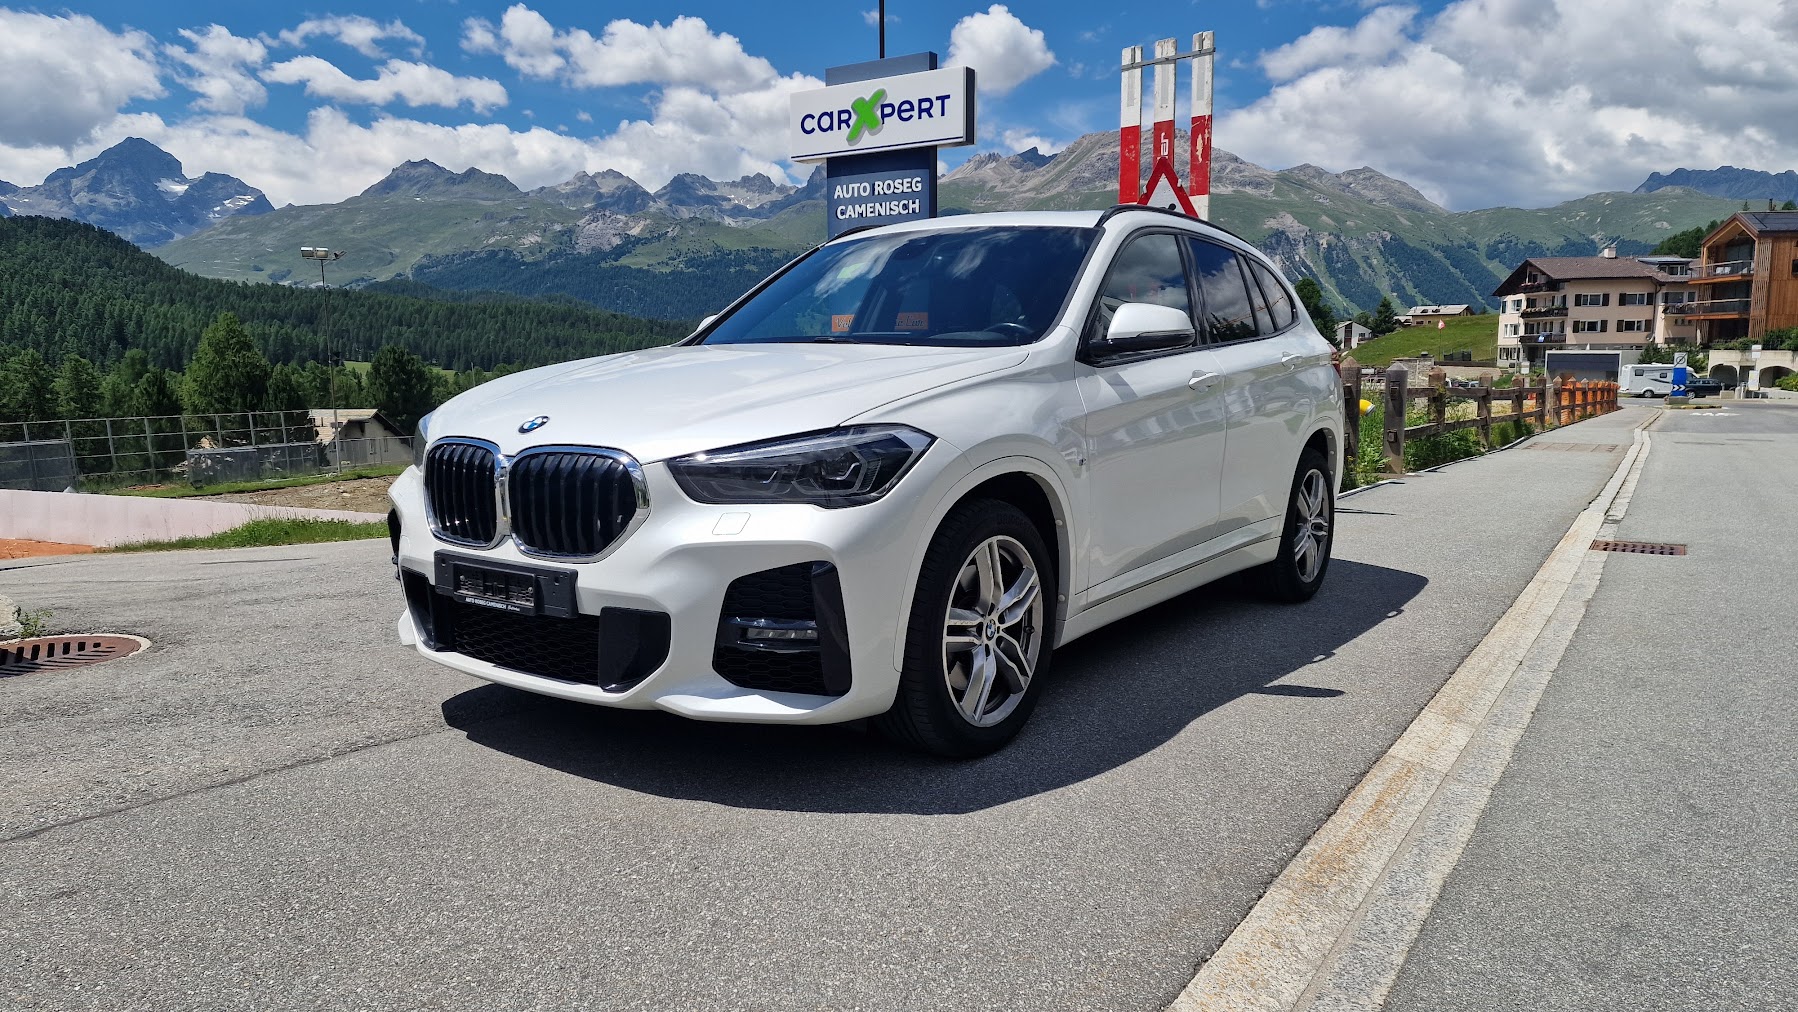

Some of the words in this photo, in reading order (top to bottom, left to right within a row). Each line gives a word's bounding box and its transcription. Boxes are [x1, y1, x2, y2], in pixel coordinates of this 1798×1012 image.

[834, 182, 870, 199] AUTO
[874, 177, 922, 196] ROSEG
[836, 199, 920, 220] CAMENISCH
